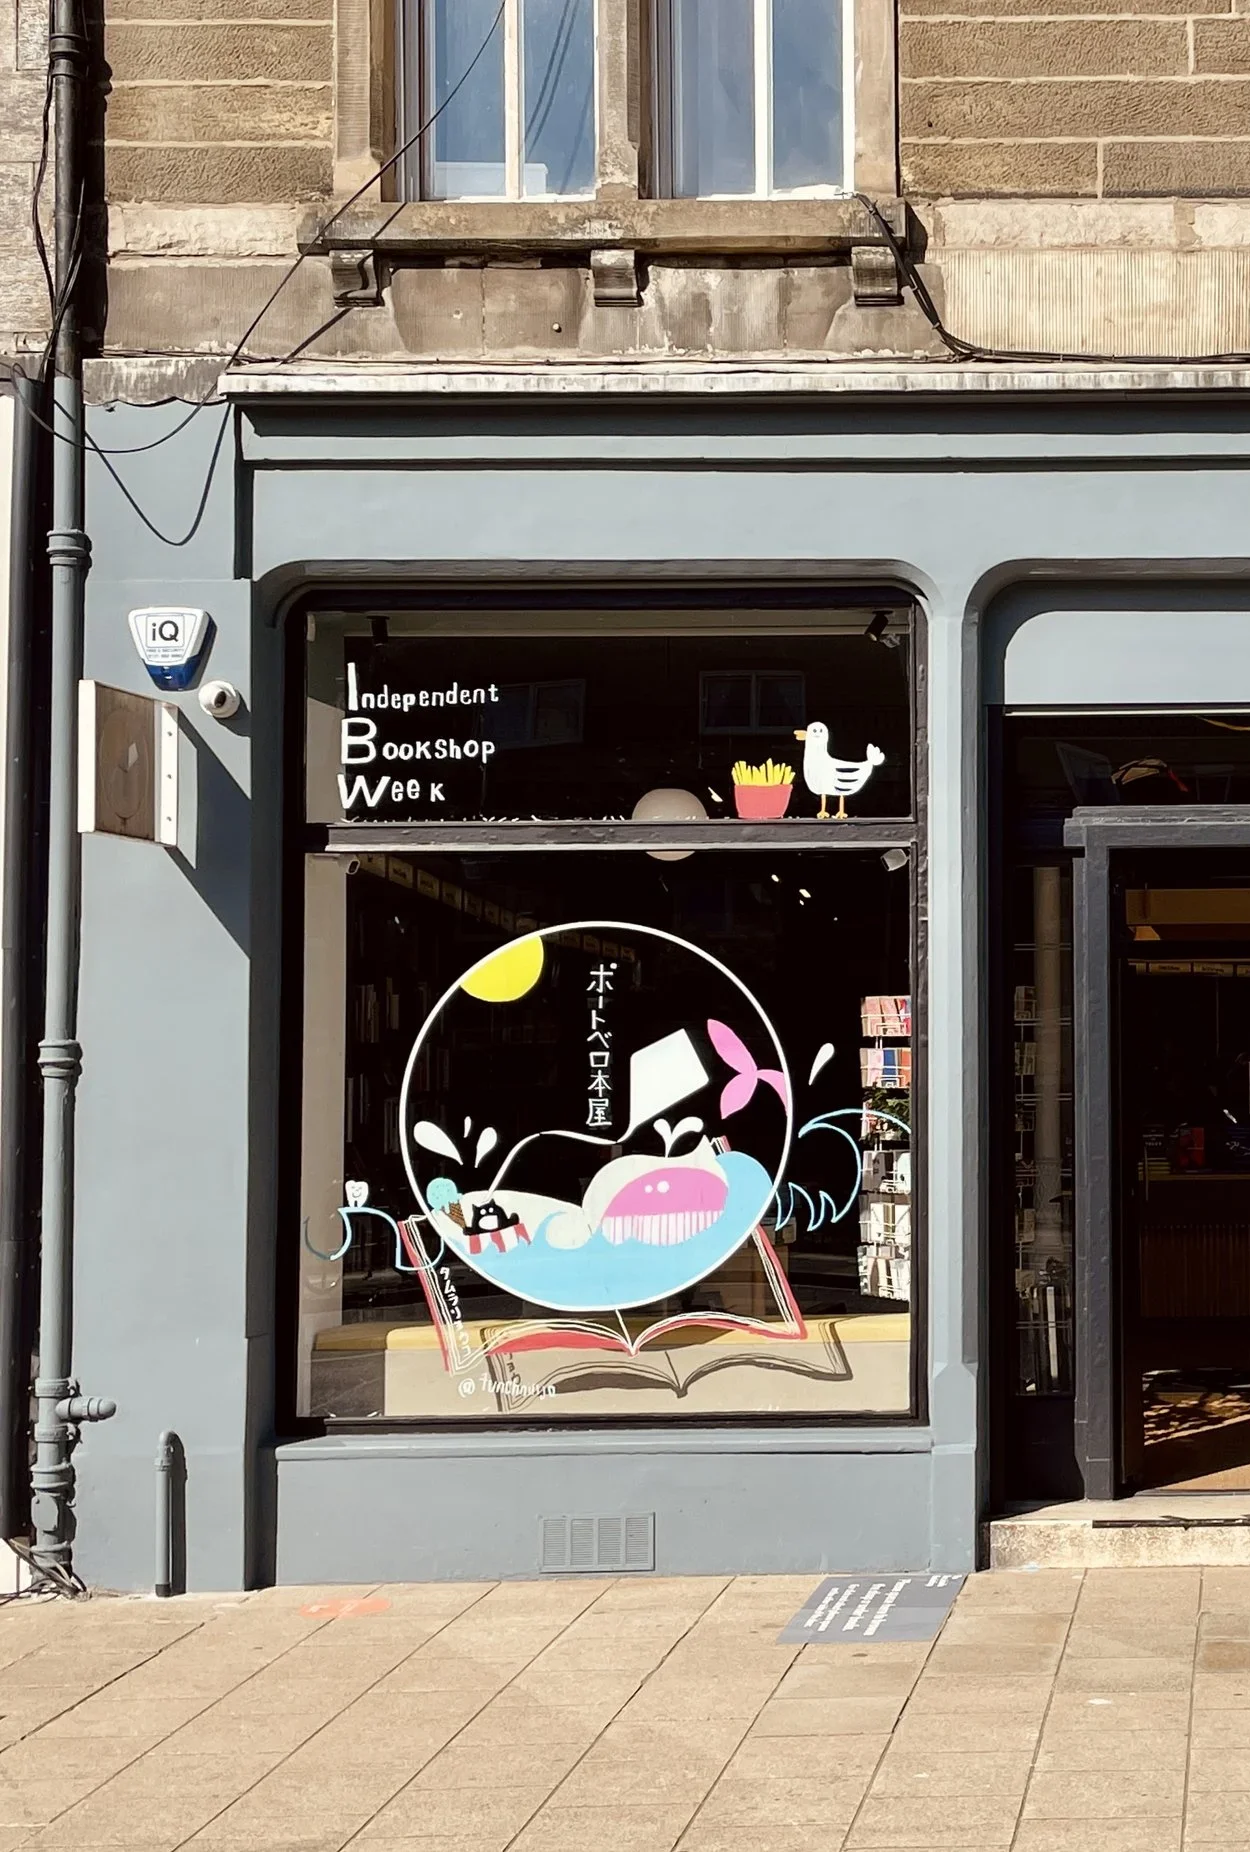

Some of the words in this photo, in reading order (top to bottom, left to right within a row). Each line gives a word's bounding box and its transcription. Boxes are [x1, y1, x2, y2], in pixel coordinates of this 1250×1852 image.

[152, 620, 179, 642] iQ
[347, 662, 499, 712] Independent
[586, 962, 618, 1127] ポートベロ本屋
